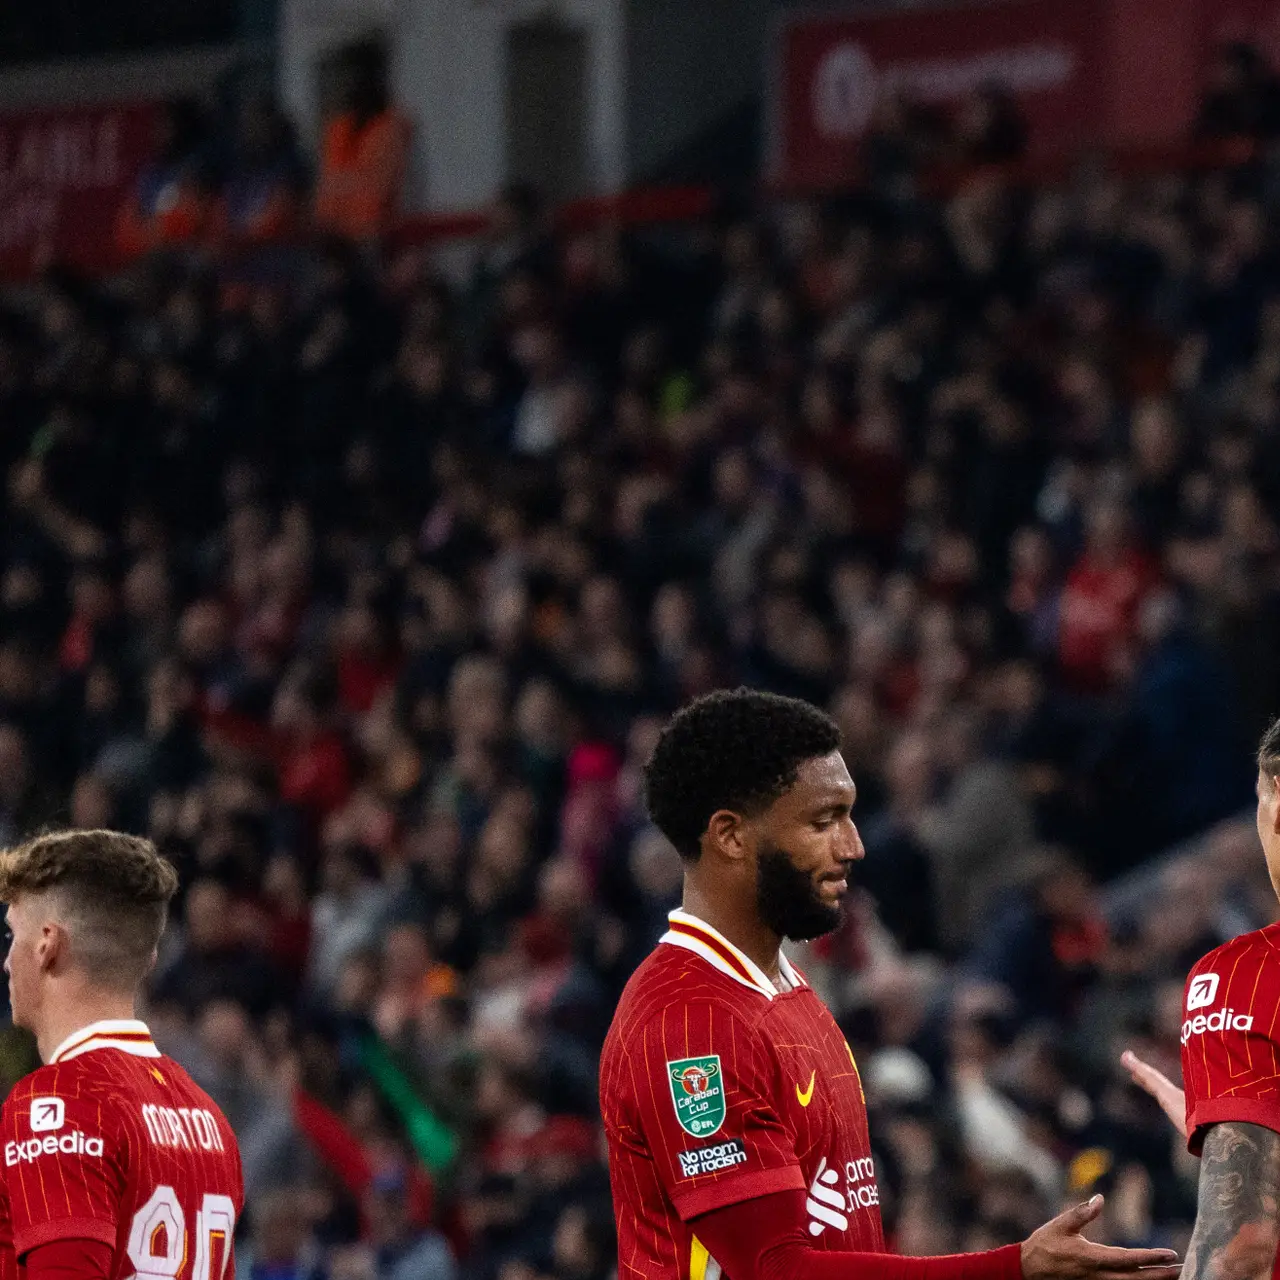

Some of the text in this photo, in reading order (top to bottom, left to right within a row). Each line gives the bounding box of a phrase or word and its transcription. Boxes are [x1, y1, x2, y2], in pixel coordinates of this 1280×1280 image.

[1180, 1007, 1254, 1047] pedia
[678, 1086, 720, 1109] Carabao
[689, 1101, 709, 1115] Cup
[142, 1103, 224, 1152] MORTON
[4, 1131, 104, 1167] Expedia
[679, 1141, 738, 1165] No room
[682, 1151, 747, 1177] for racism
